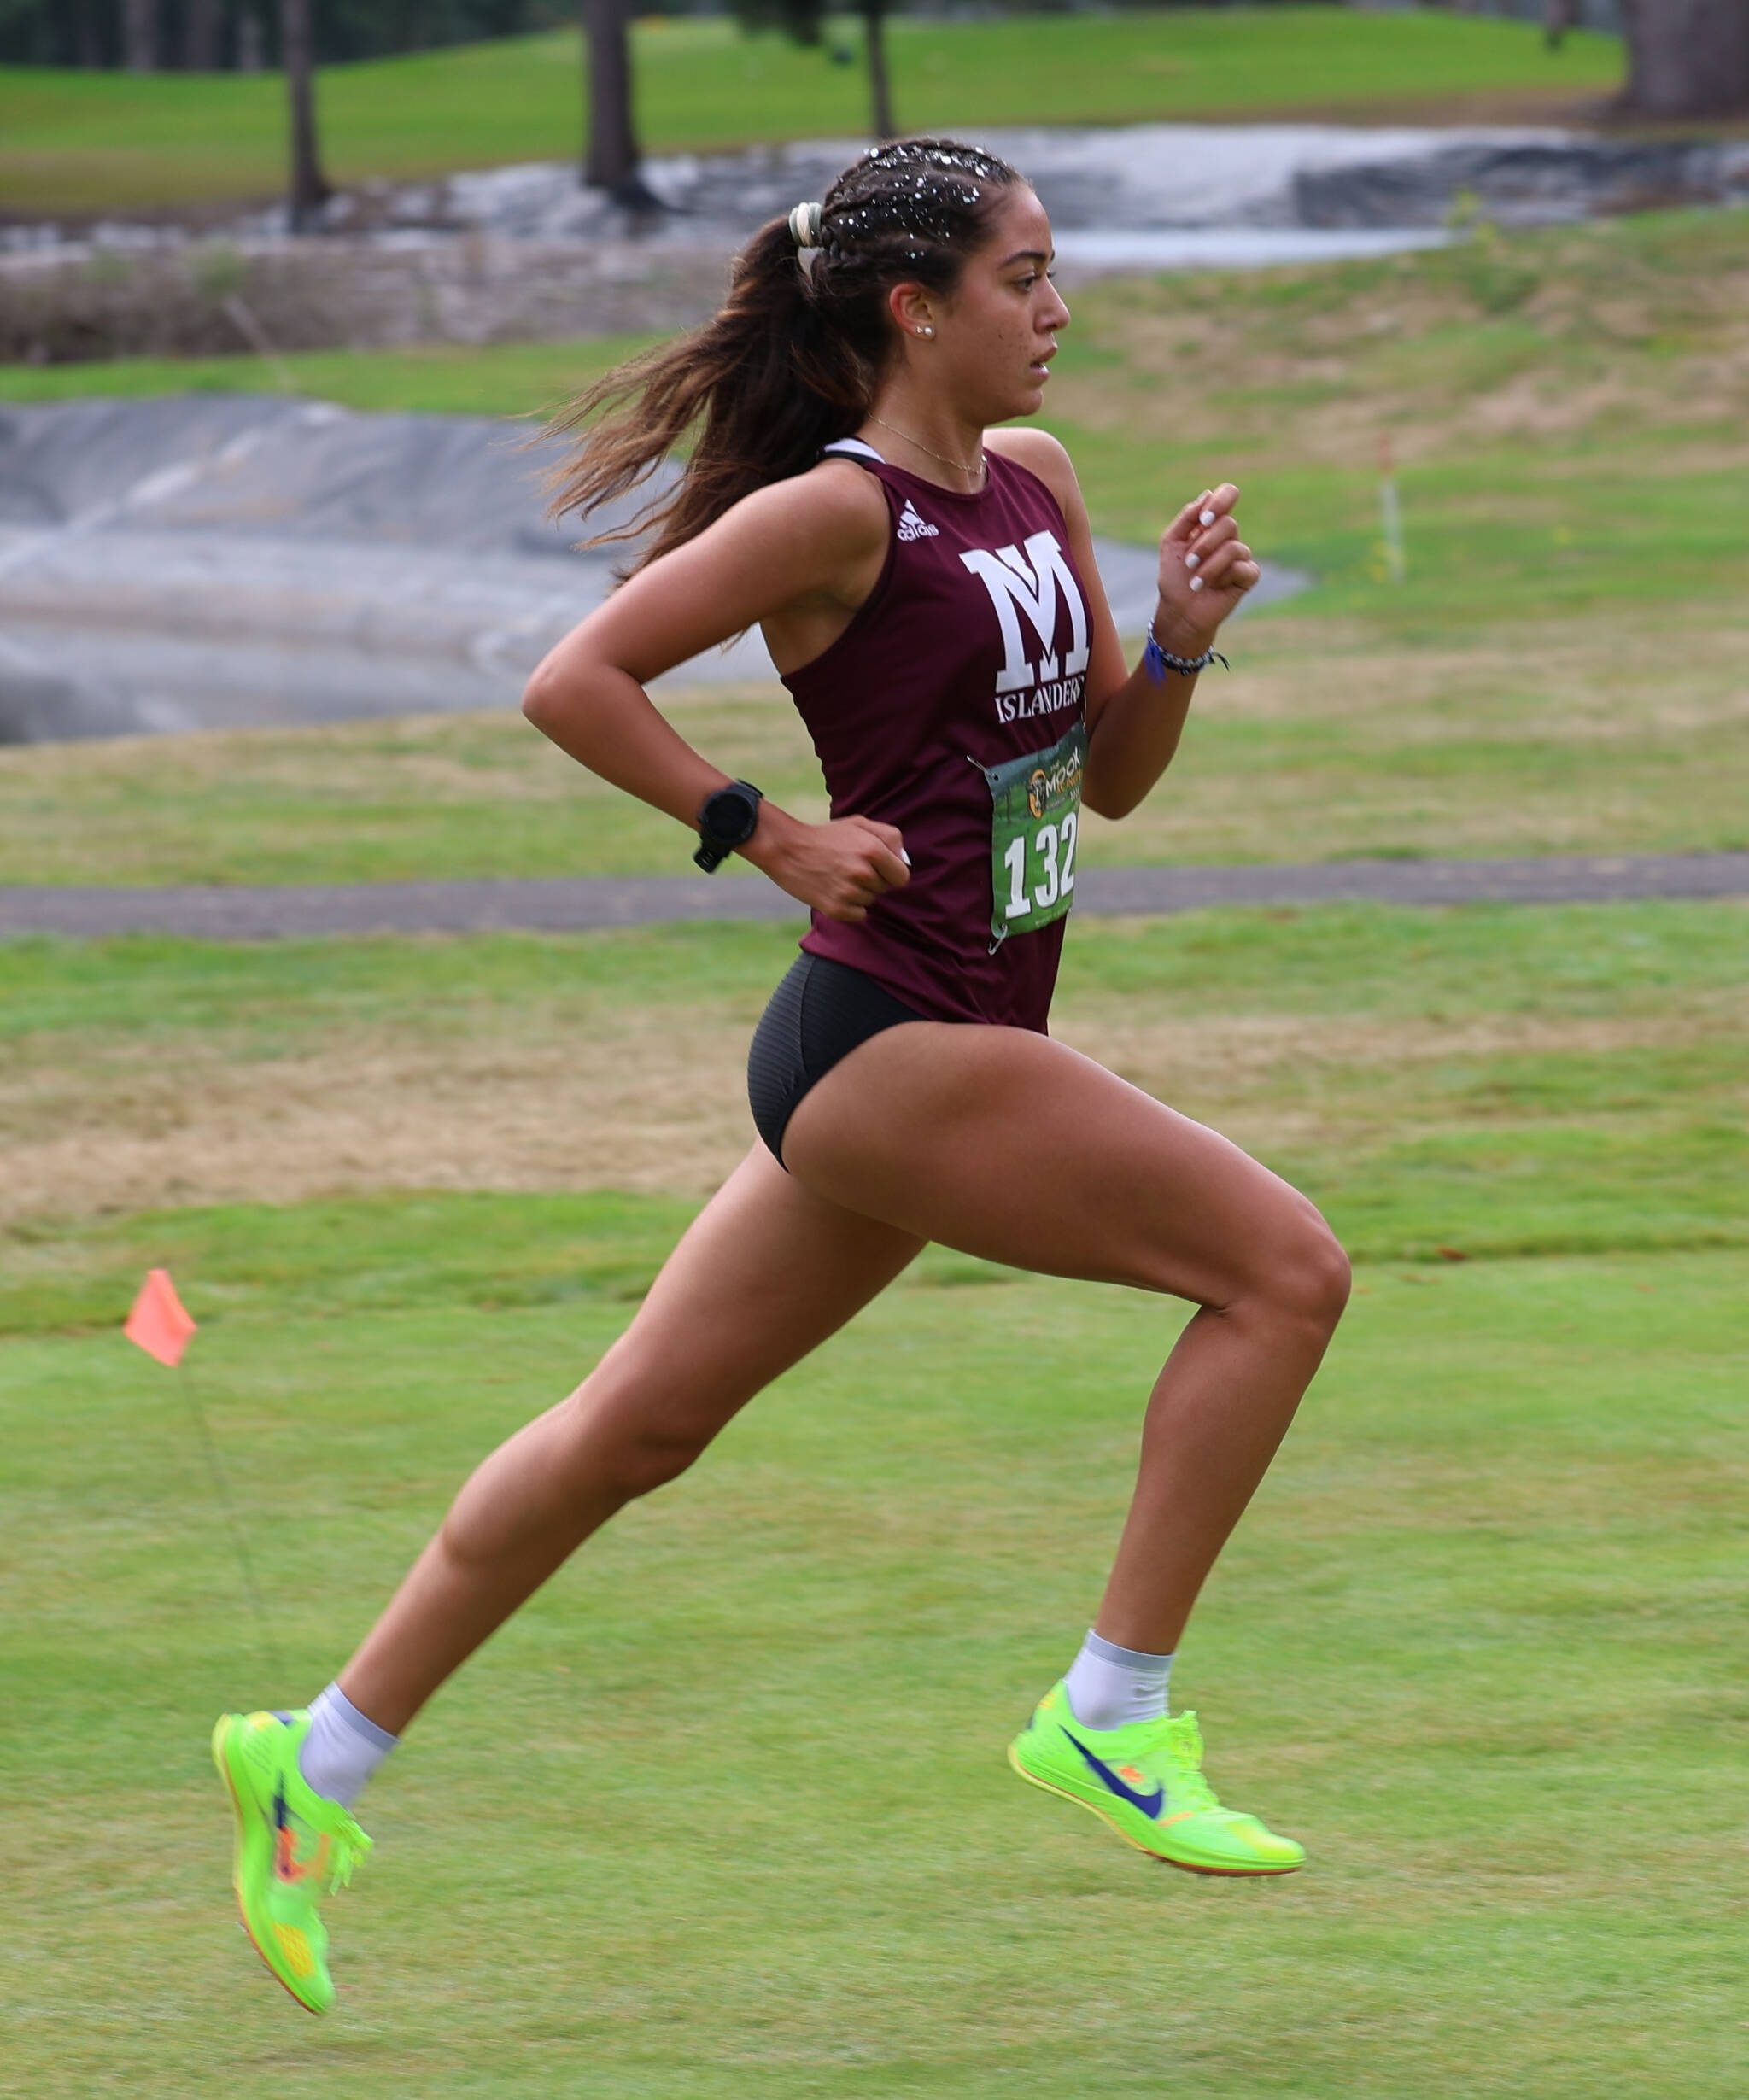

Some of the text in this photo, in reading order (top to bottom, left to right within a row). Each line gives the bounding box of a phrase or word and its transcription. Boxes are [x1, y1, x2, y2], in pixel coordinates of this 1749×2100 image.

[897, 524, 939, 541] adidas
[958, 530, 1090, 693] M
[1004, 811, 1077, 920] 132
